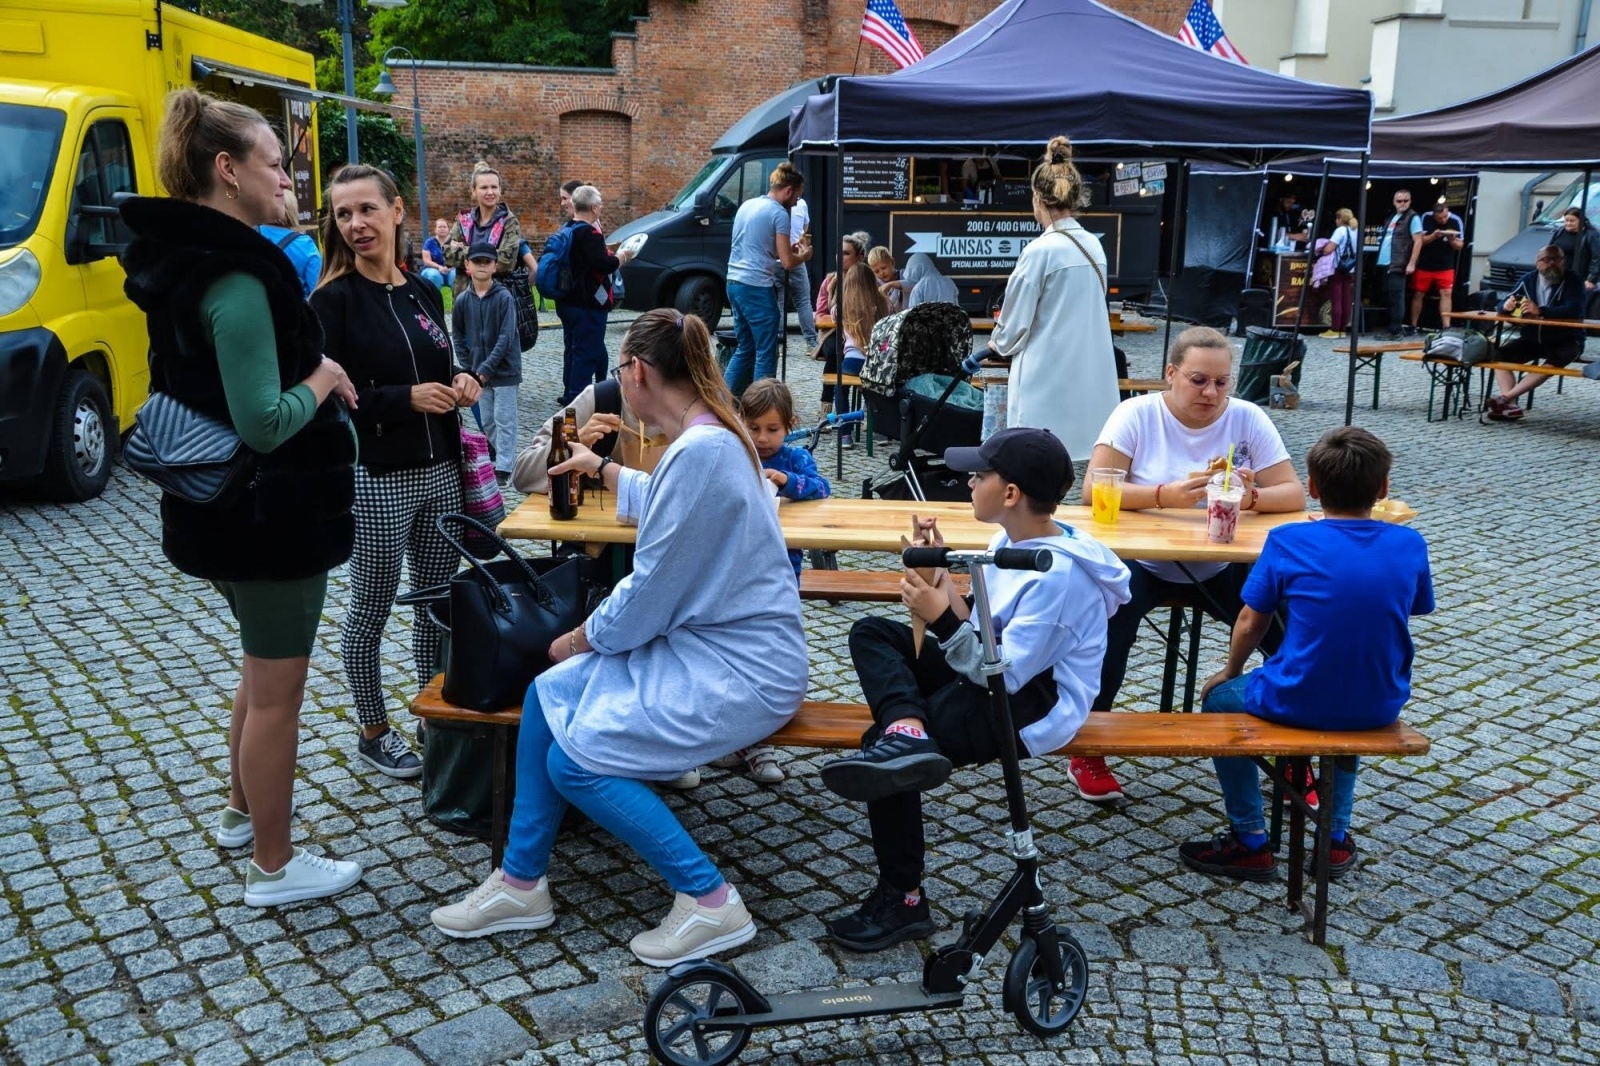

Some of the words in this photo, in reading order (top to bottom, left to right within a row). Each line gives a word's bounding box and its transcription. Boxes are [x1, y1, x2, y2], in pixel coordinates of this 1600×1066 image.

[967, 221, 983, 232] 200
[984, 221, 990, 232] G
[996, 221, 1012, 232] 400
[1013, 221, 1019, 232] G
[940, 239, 992, 255] KANSAS
[822, 994, 873, 1005] lionelo
